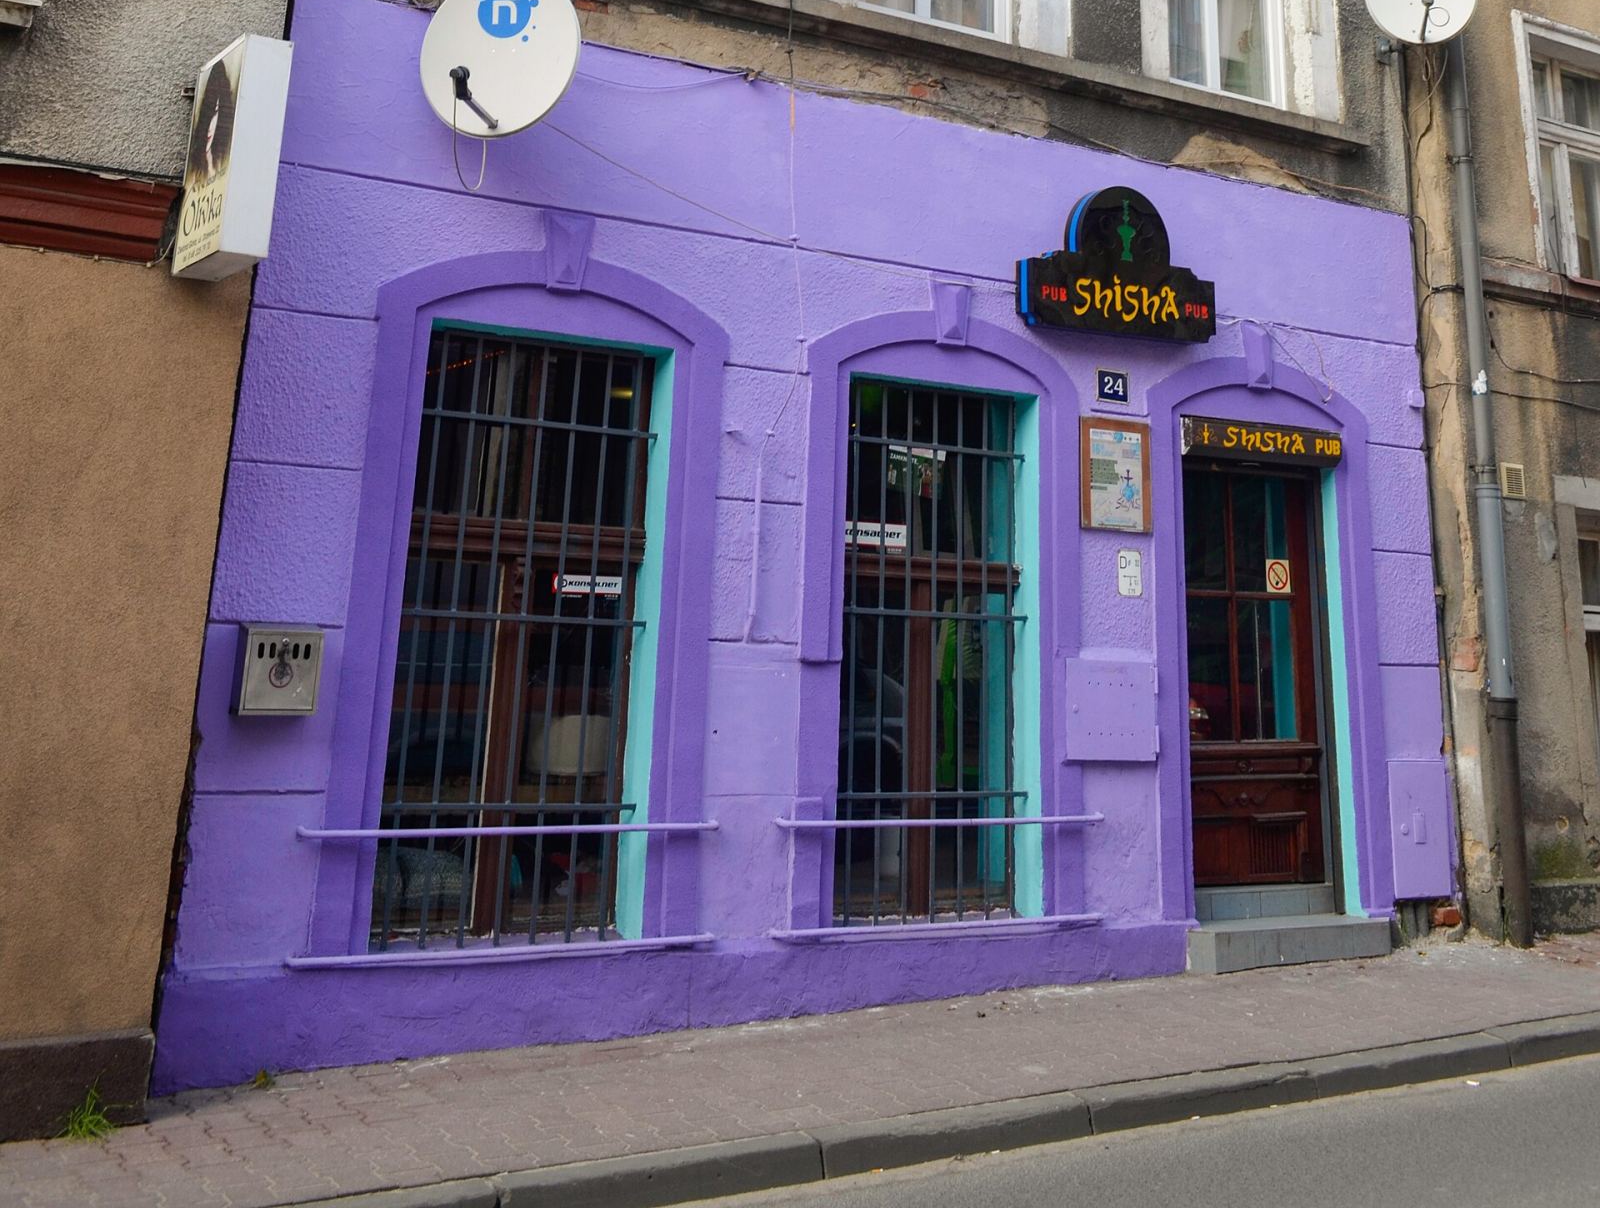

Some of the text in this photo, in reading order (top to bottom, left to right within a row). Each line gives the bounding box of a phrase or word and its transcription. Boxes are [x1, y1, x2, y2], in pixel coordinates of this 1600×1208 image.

[1042, 285, 1068, 302] PUB
[1184, 302, 1209, 319] PUB
[1104, 376, 1124, 396] 24
[1315, 438, 1341, 456] PUB
